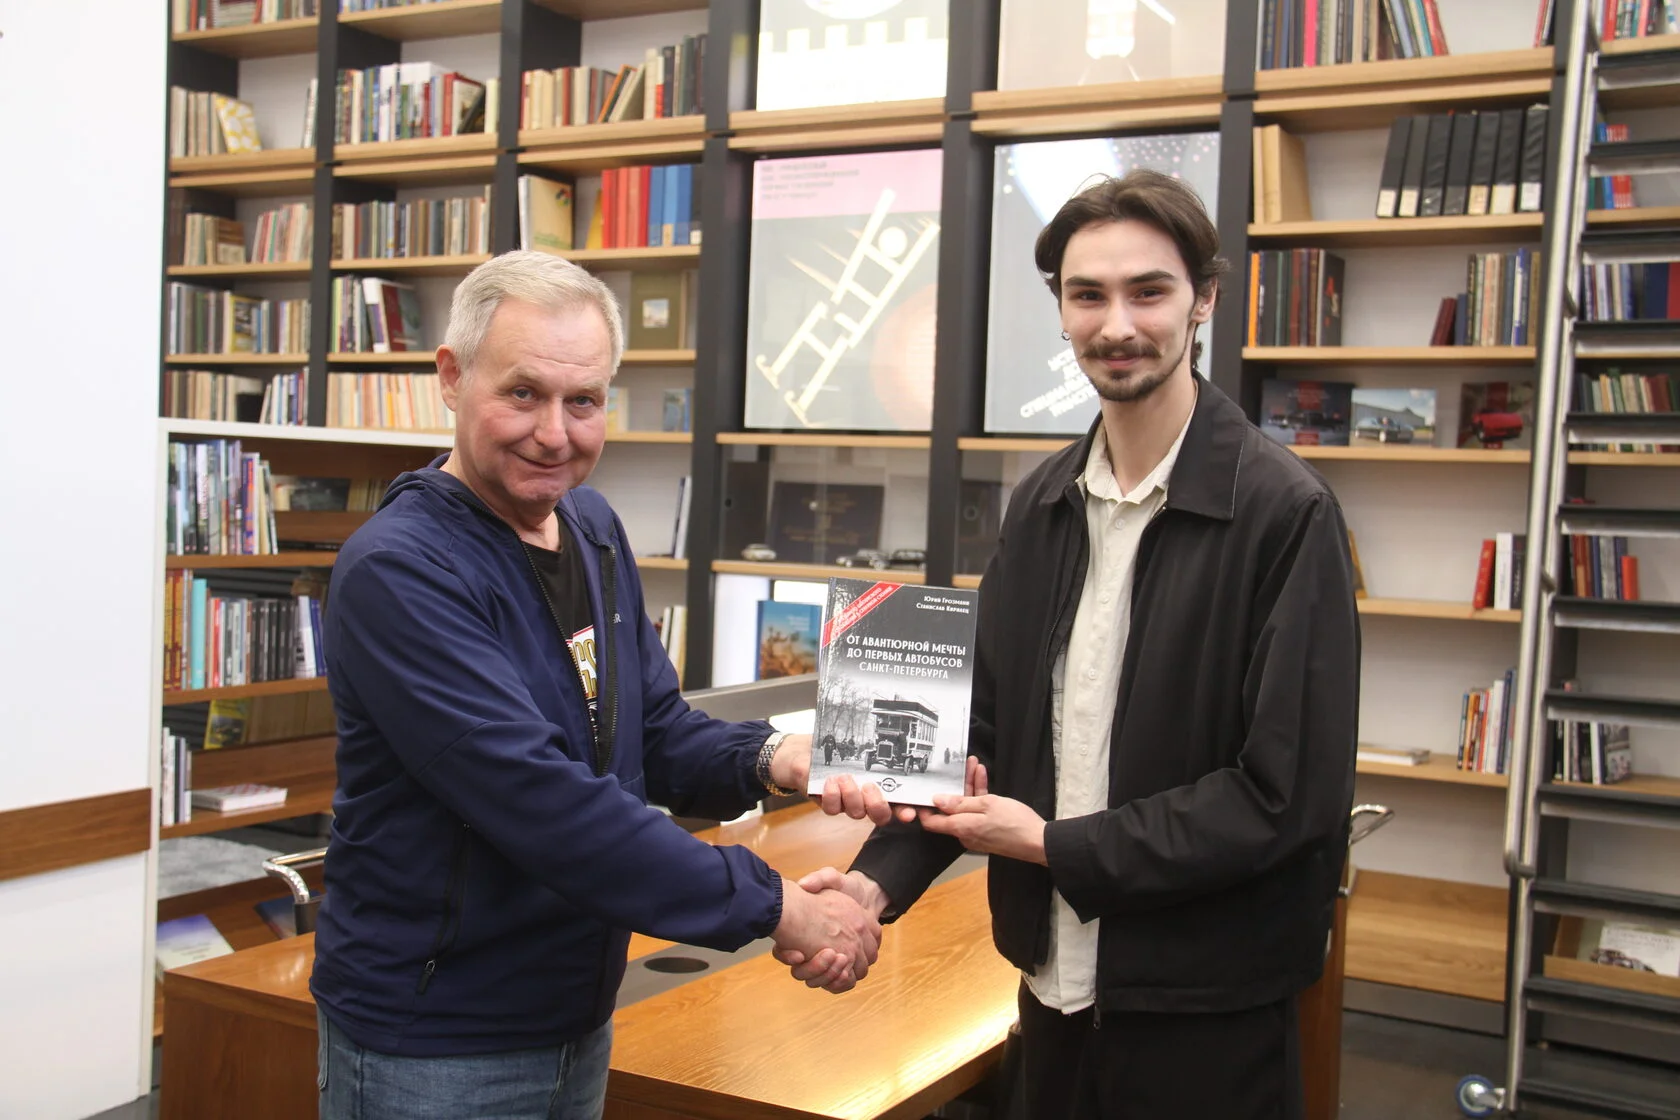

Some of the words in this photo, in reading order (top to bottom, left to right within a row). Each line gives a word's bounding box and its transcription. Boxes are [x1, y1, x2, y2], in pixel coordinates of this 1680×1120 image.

[846, 635, 860, 645] ОТ
[862, 636, 930, 652] АВАНТЮРНОЙ
[932, 643, 966, 656] МЕЧТЫ
[846, 647, 862, 658] ДО
[864, 649, 902, 662] ПЕРВЫХ
[904, 653, 963, 668] АВТОБУСОВ
[859, 661, 949, 679] САНКТ-ПЕТЕРБУРГА
